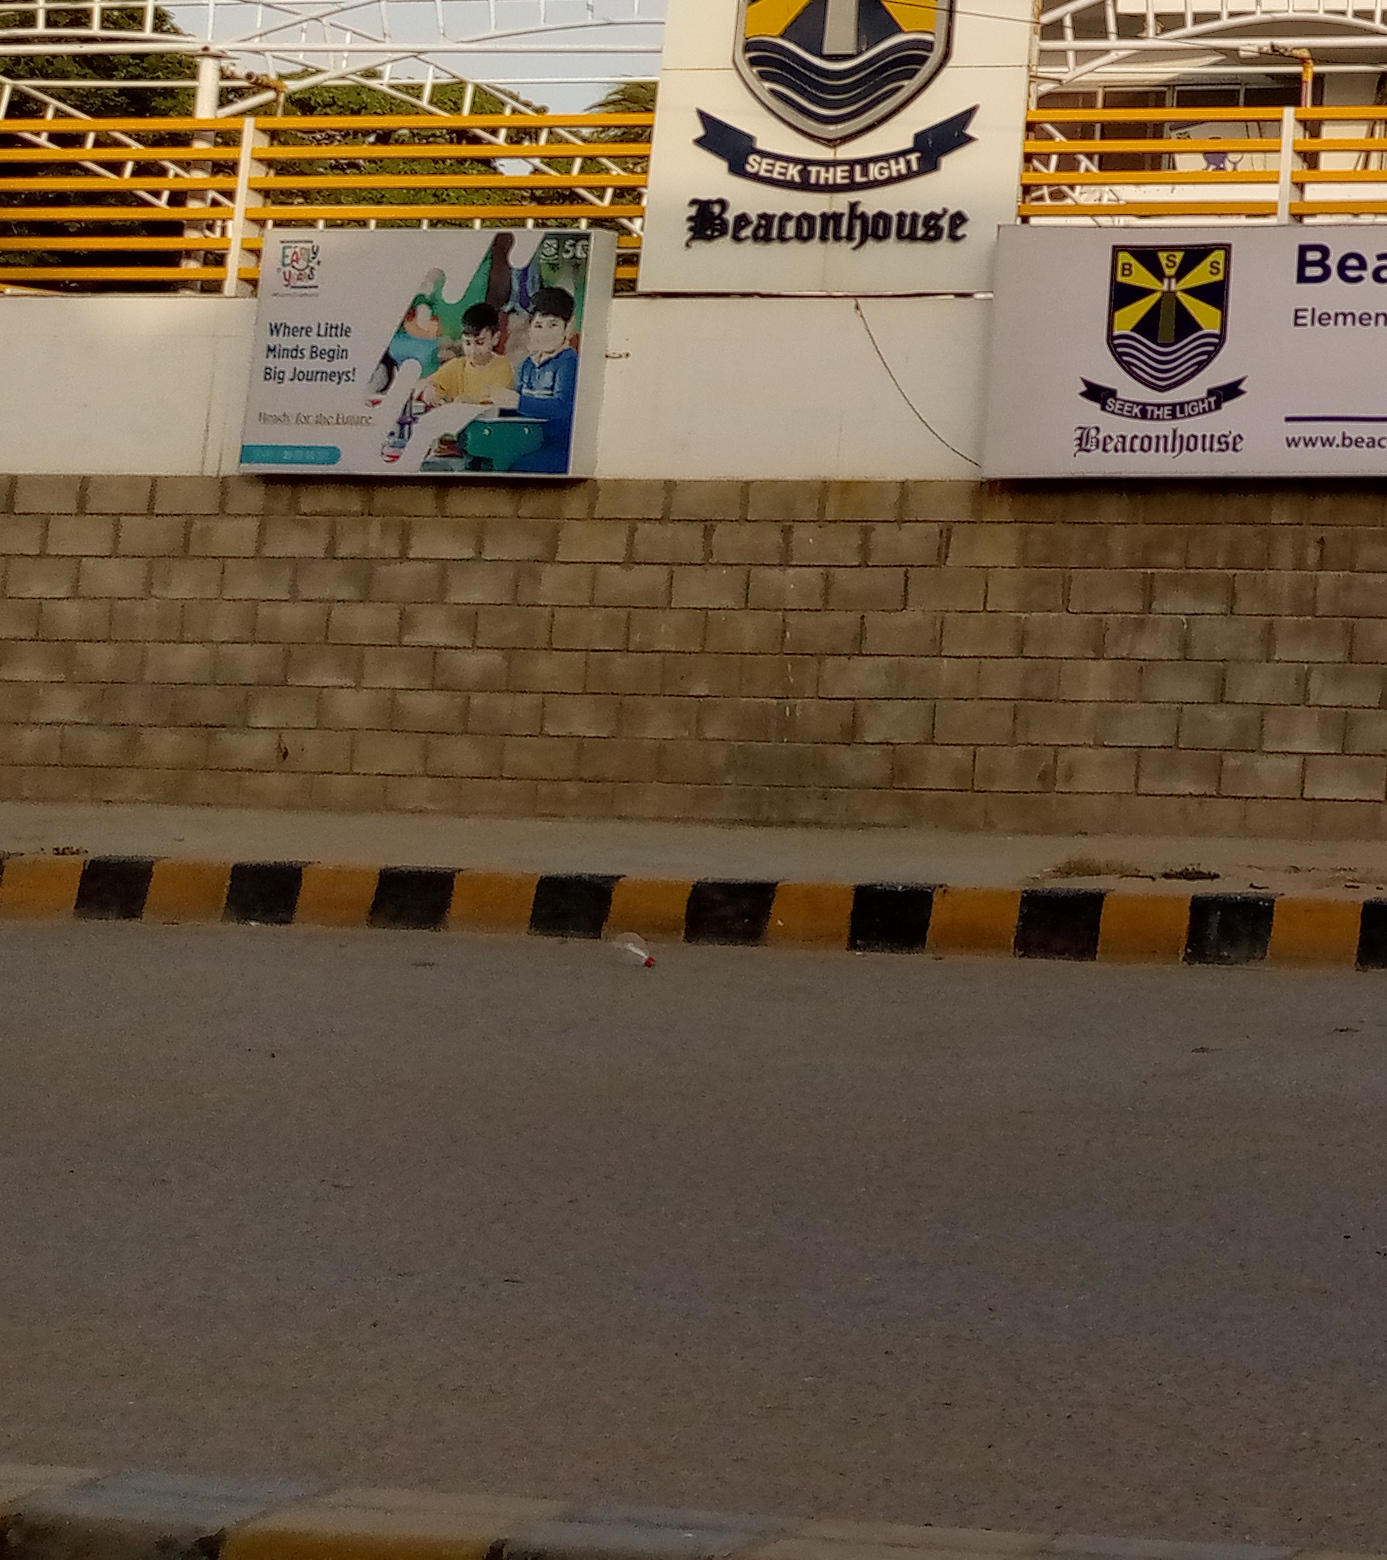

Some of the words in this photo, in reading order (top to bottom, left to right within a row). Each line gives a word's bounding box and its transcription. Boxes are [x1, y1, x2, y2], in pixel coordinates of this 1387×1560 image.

[745, 155, 803, 182] SEEK
[807, 165, 850, 184] THE
[854, 152, 922, 183] LIGHT
[685, 198, 970, 250] Beaconhouse
[1121, 263, 1133, 277] B
[1165, 254, 1176, 268] S
[1209, 261, 1220, 275] S
[269, 322, 313, 338] Where
[317, 322, 352, 338] Little
[265, 344, 306, 359] Minds
[309, 344, 349, 362] Begin
[264, 366, 286, 384] Big
[289, 367, 356, 385] Journeys!
[1105, 398, 1142, 418] SEEK
[1146, 406, 1172, 419] THE
[1176, 397, 1217, 418] LIGHT
[1073, 425, 1244, 459] Beaconhouse
